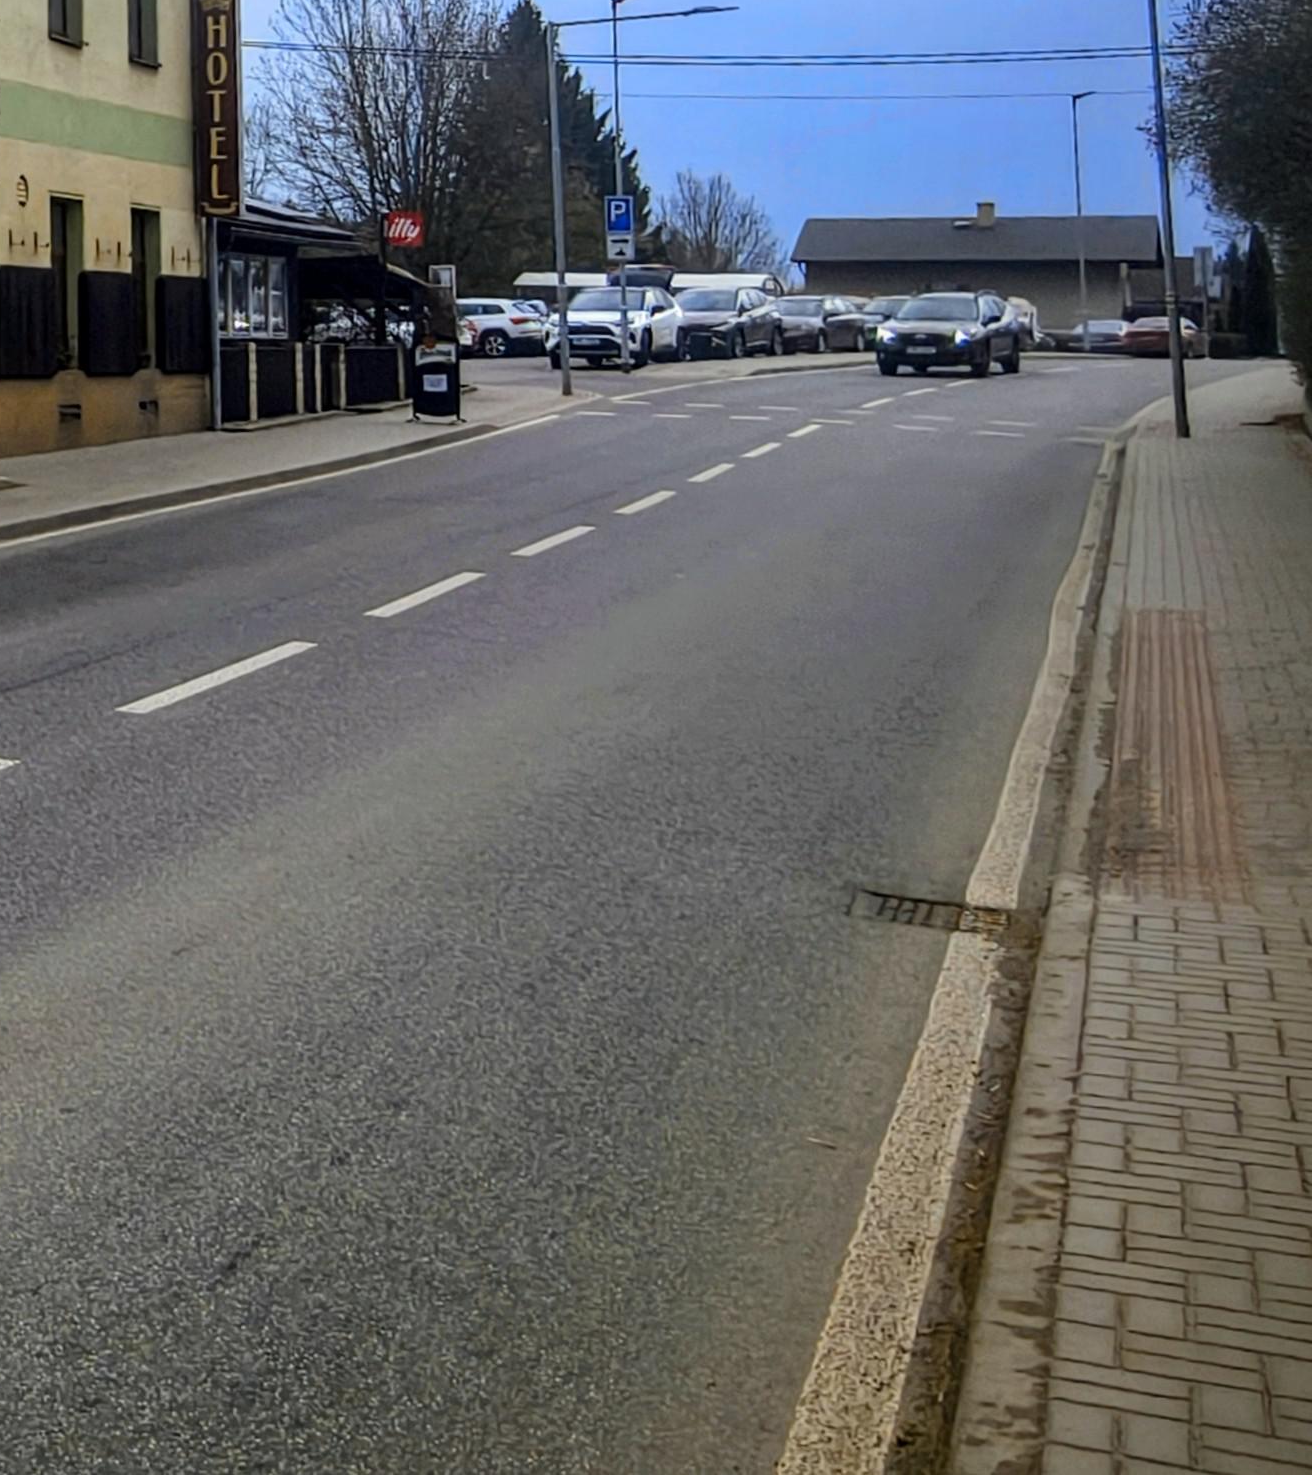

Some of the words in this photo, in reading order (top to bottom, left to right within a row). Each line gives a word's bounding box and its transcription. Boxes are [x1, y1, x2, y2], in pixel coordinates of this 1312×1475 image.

[206, 15, 230, 199] HOTEL
[610, 201, 626, 222] P
[388, 216, 421, 243] illy
